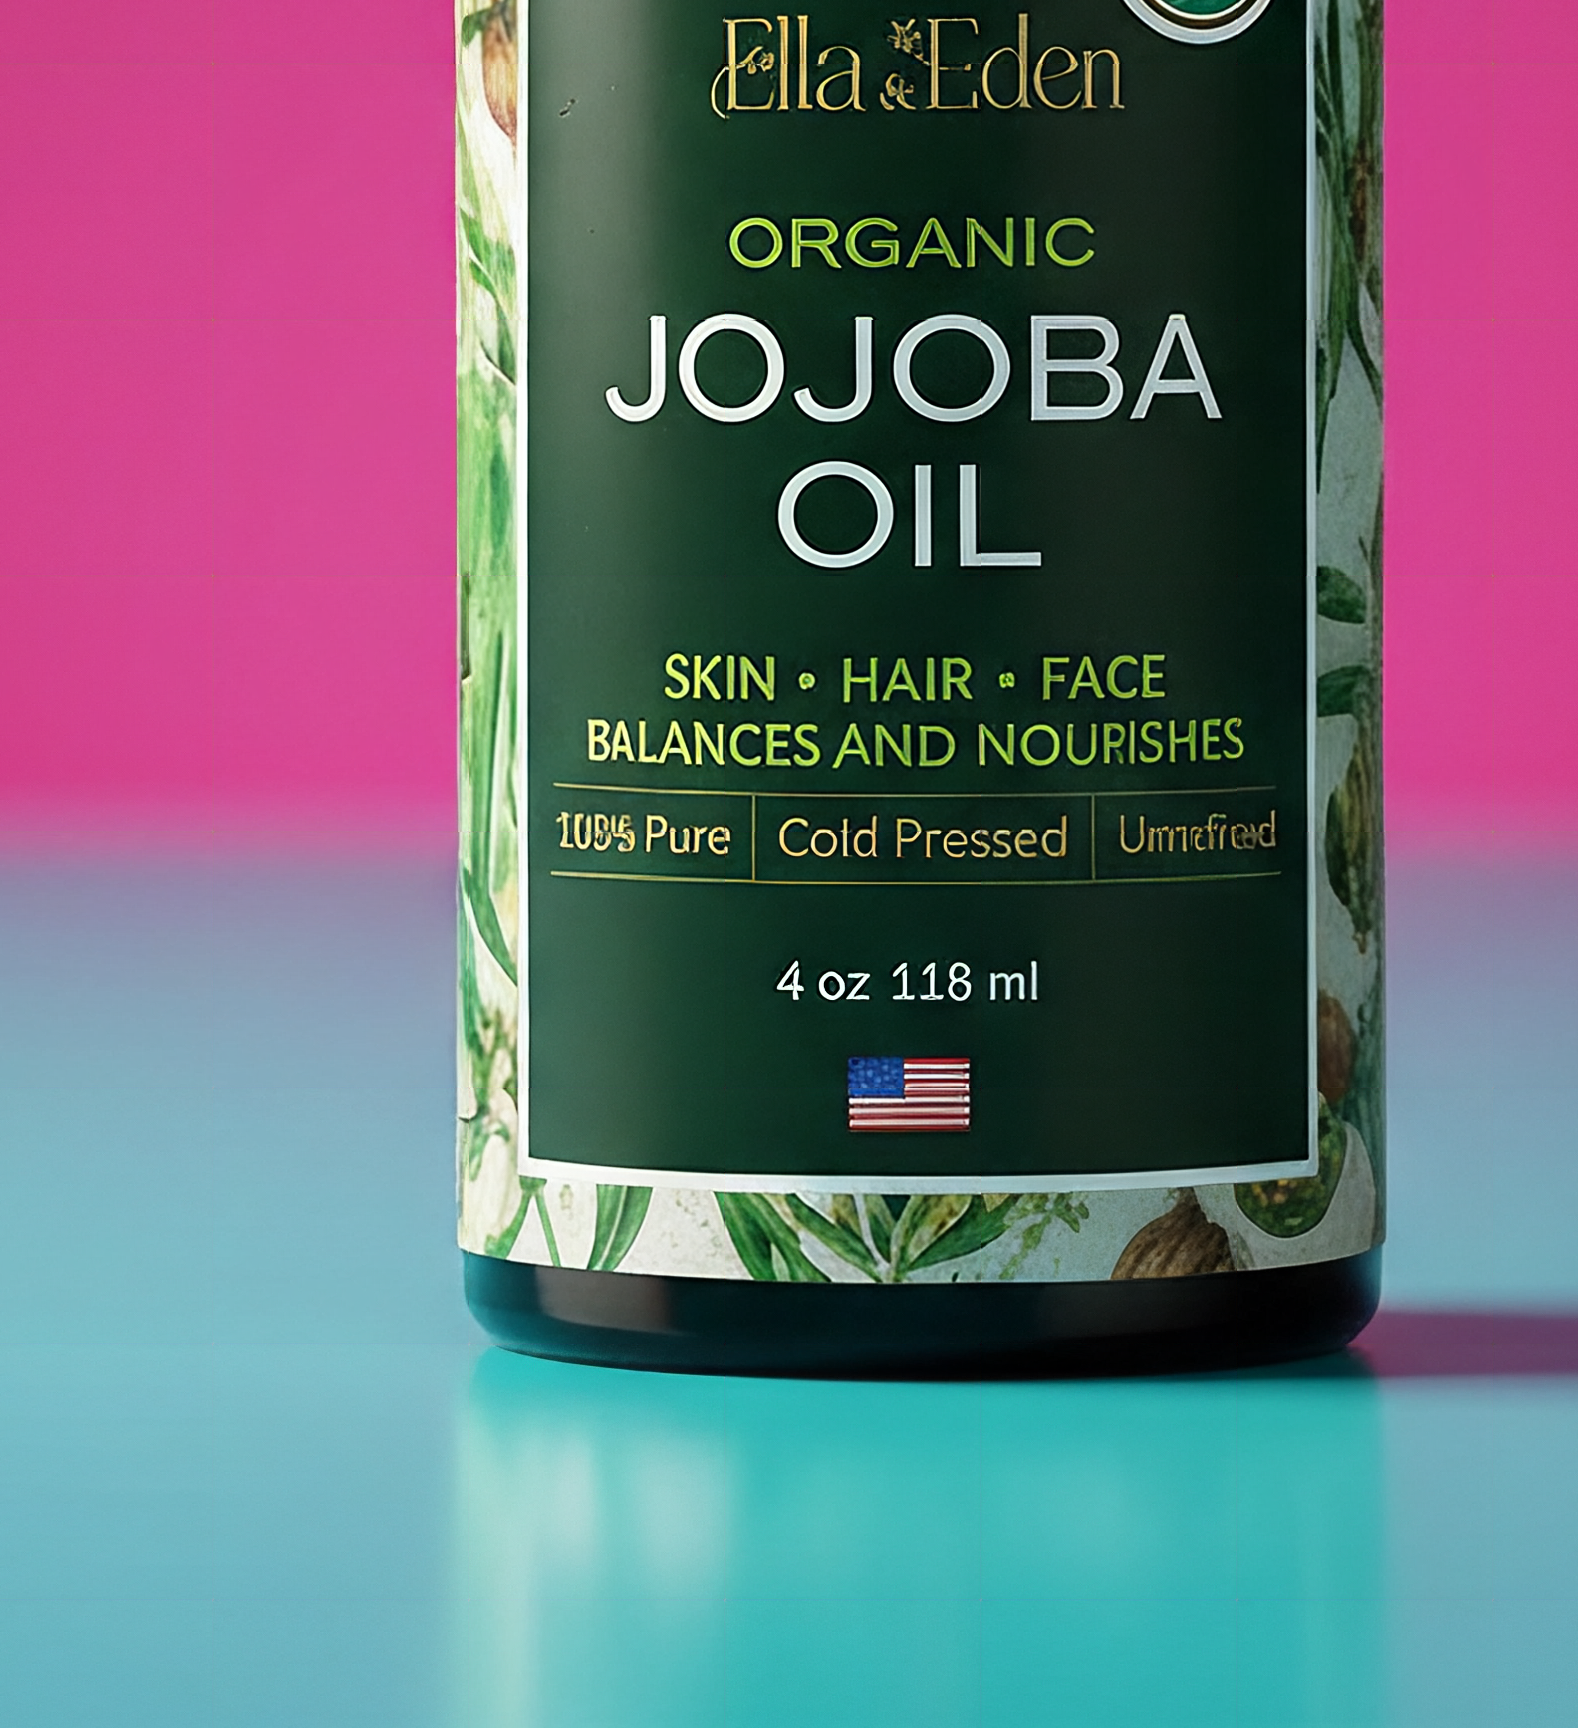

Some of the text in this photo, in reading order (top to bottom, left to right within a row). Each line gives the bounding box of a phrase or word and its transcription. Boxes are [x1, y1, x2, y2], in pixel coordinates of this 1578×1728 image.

[710, 14, 867, 120] Ella
[926, 13, 1125, 110] Eden
[728, 217, 1096, 269] ORGANIC
[605, 313, 1222, 423] JOJOBA
[777, 460, 1042, 569] OIL
[664, 653, 1166, 703] SKIN HAIR FACE
[587, 717, 1245, 769] BALANCES AND NOURISHES
[645, 814, 731, 855] Pure
[778, 814, 1068, 859] Cold Pressed
[776, 959, 1039, 1002] 4 oz 118 ml
